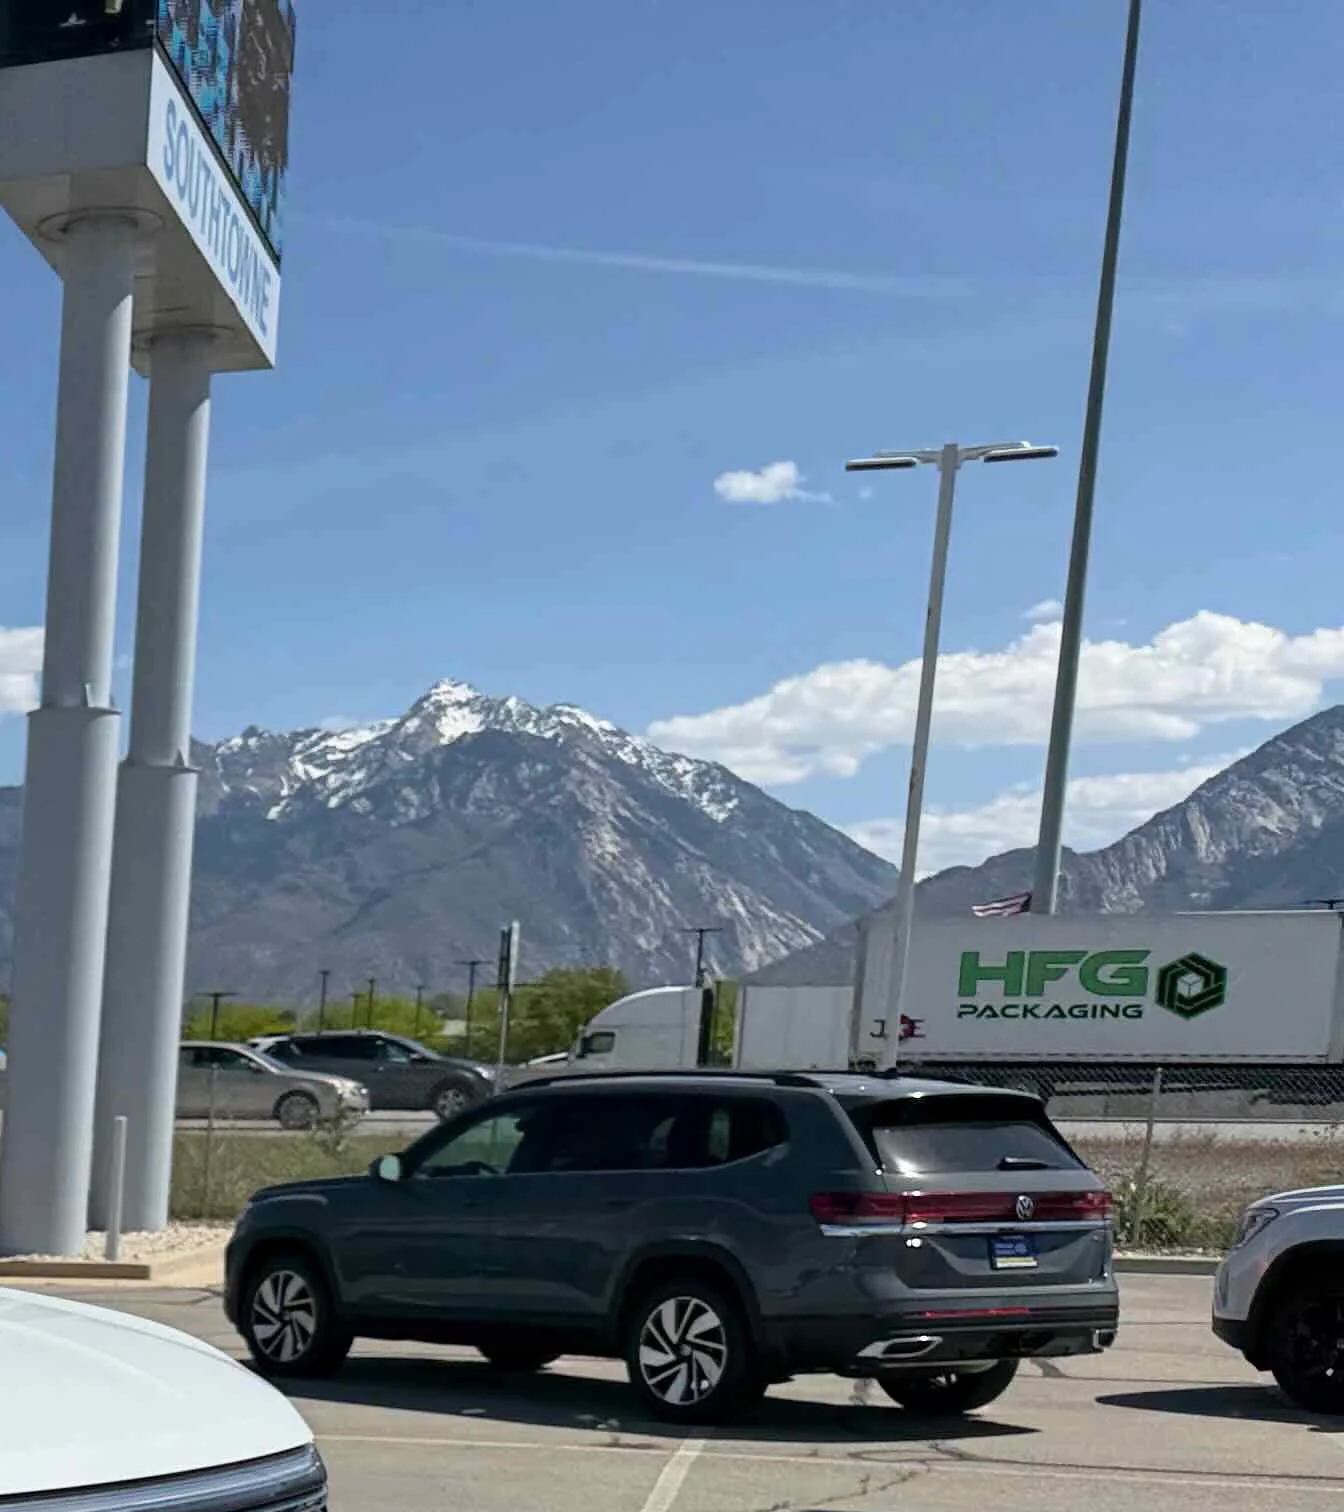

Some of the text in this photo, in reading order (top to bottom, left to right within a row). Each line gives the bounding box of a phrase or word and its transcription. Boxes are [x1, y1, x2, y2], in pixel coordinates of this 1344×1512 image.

[164, 98, 272, 336] SOUTHTOWNE
[958, 950, 1151, 997] HFG
[870, 1015, 926, 1041] JE
[957, 1004, 1143, 1018] PACKAGING
